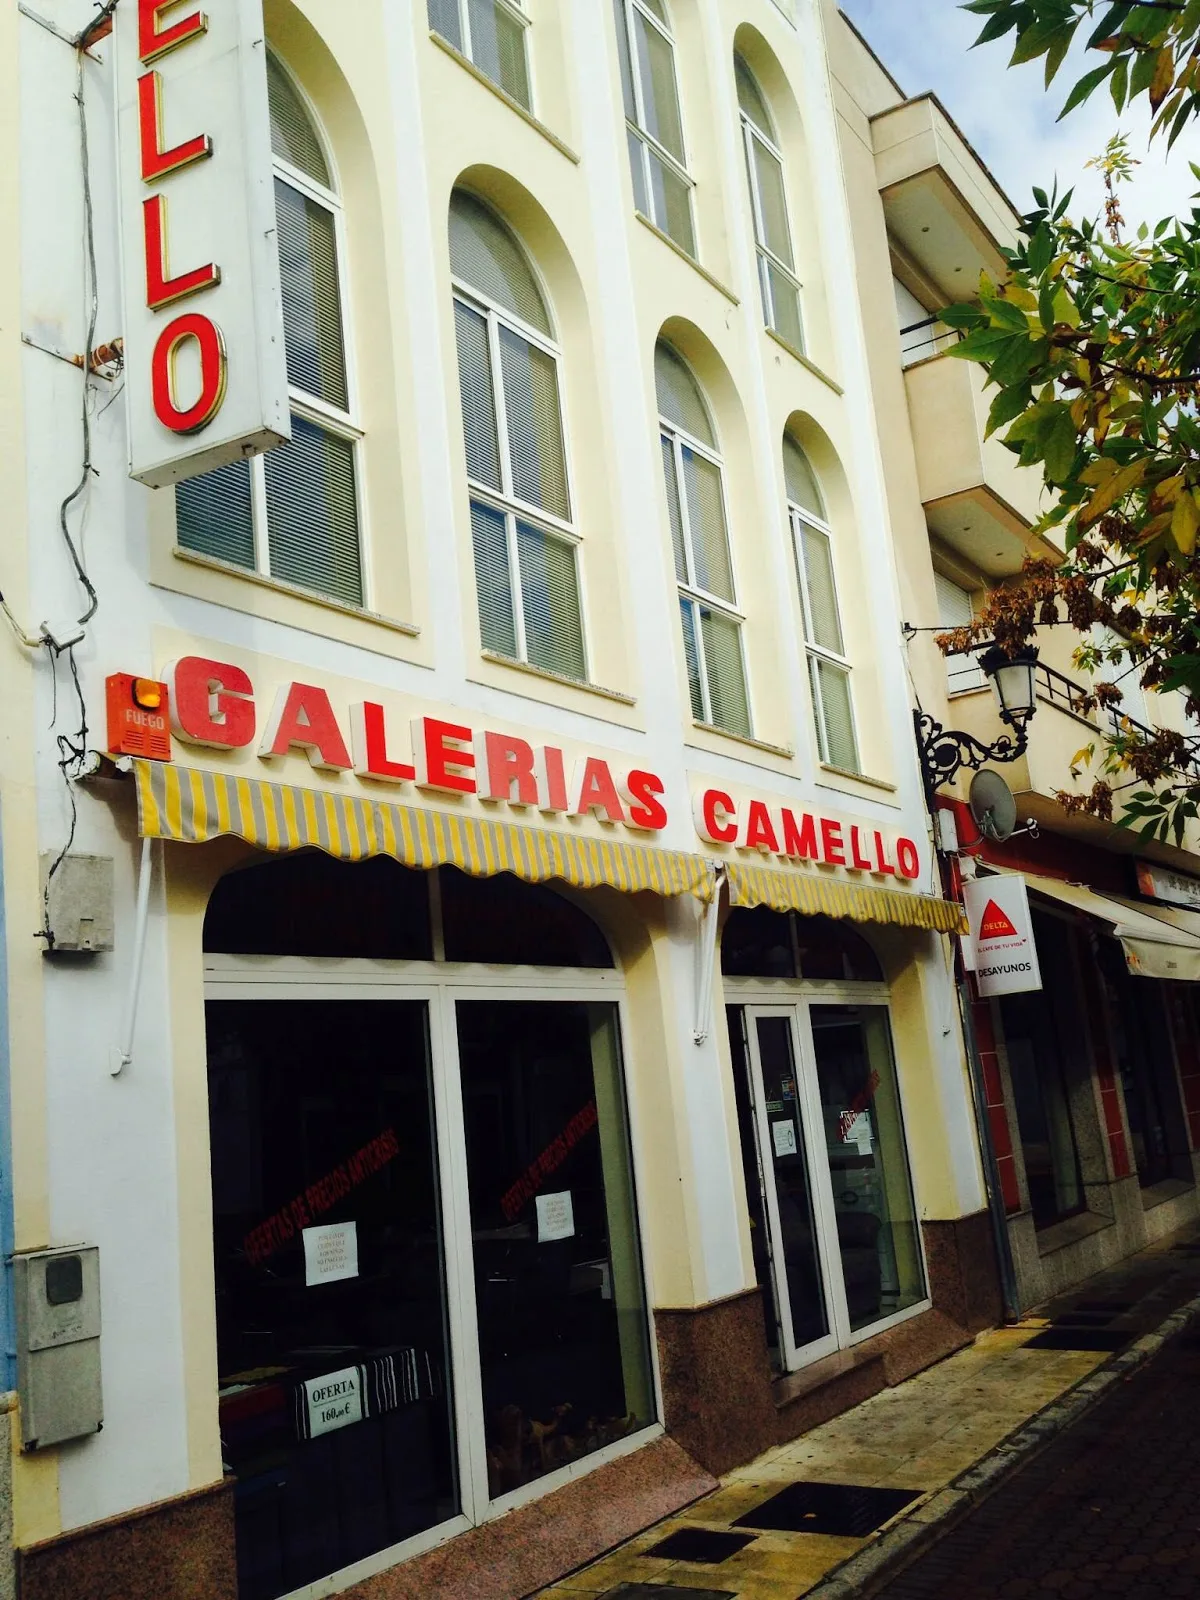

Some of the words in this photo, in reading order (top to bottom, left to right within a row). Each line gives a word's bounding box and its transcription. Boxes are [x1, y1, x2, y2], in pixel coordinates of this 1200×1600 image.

[126, 709, 165, 730] FUEGO
[168, 656, 667, 831] GALERIAS
[696, 789, 920, 880] CAMELLO
[983, 921, 1009, 931] DELTA
[979, 962, 1031, 978] DESAYUNOS
[312, 1380, 355, 1403] OFERTA
